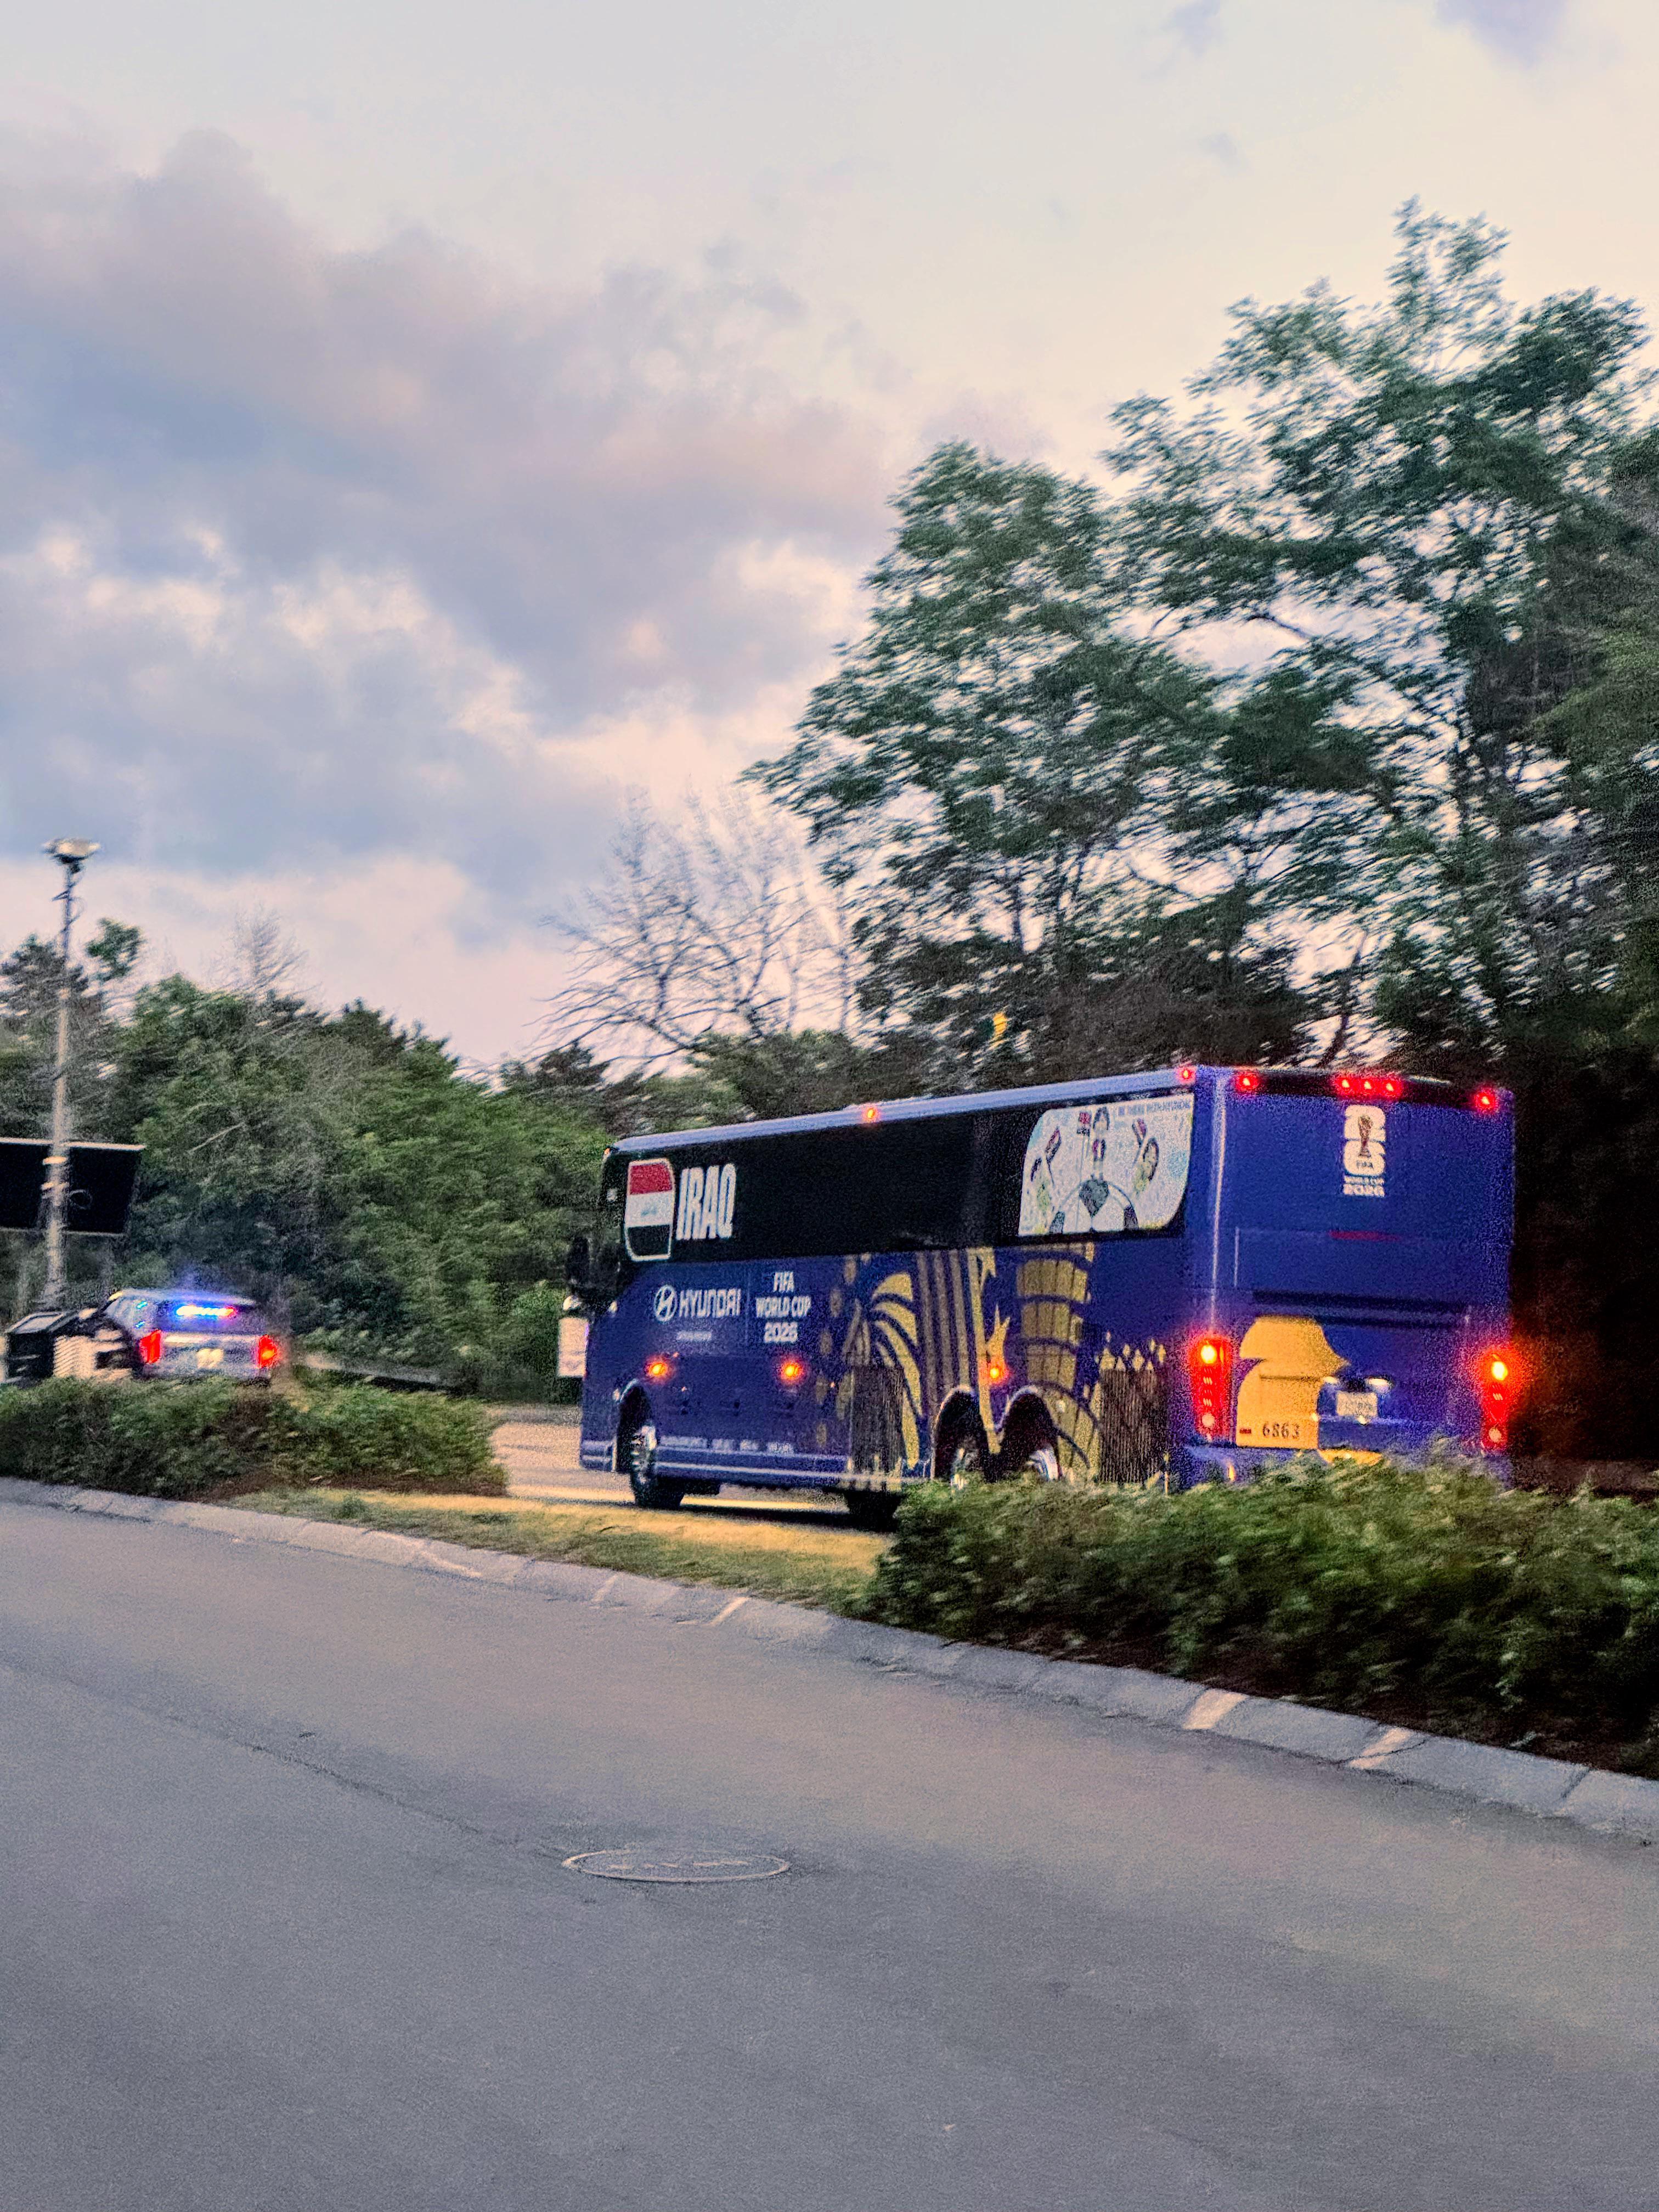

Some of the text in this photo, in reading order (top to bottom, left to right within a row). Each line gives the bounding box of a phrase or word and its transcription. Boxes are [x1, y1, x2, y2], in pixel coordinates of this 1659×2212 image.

[676, 1164, 737, 1240] IRAQ
[773, 1271, 795, 1293] FIFA
[679, 1289, 741, 1318] HYUNDAI
[755, 1295, 812, 1318] WORLD CUP
[1262, 1421, 1300, 1439] 6863
